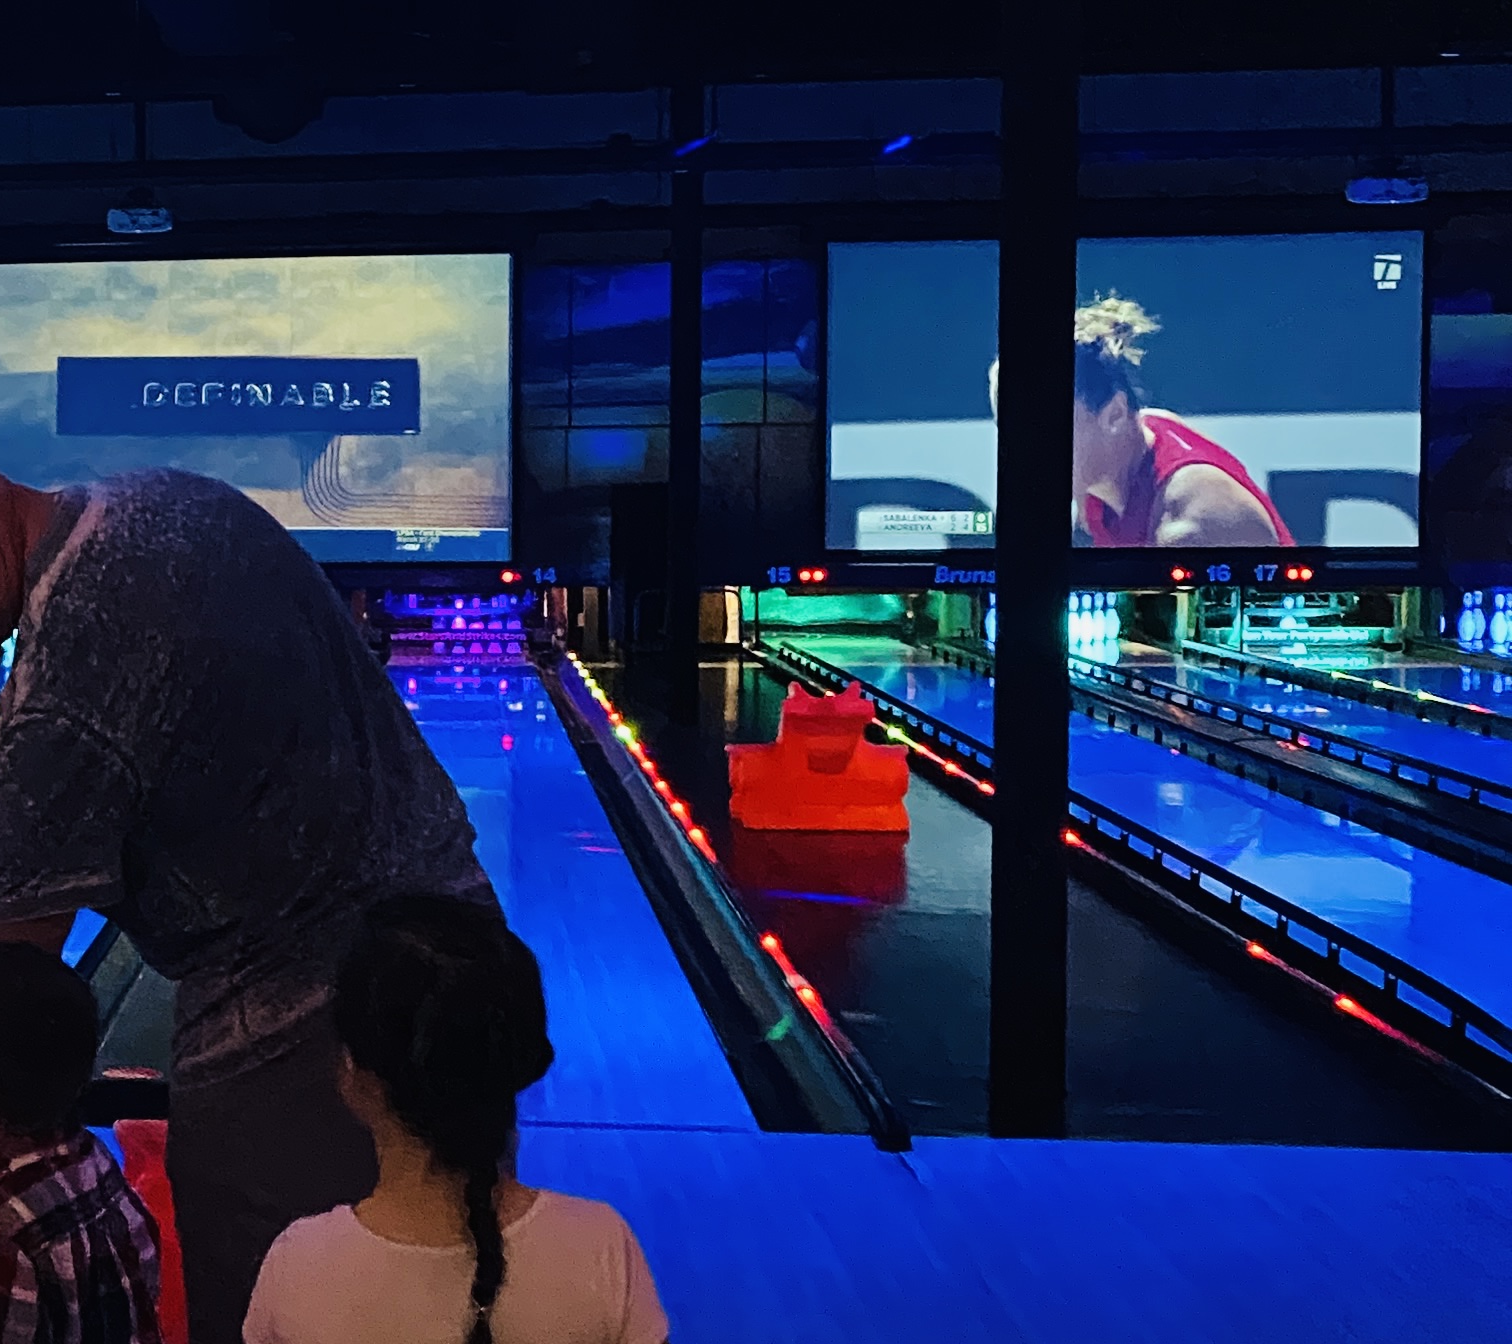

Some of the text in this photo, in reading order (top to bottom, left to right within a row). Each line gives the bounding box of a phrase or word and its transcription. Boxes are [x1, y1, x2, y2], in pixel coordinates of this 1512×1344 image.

[143, 381, 391, 411] DEFINABLE
[882, 513, 937, 522] SABALENKA
[963, 514, 970, 523] 2
[882, 523, 933, 532] ANDREEVA
[949, 523, 956, 532] 2
[532, 566, 557, 584] 14
[766, 566, 792, 584] 15
[1206, 563, 1232, 582] 16
[1254, 563, 1279, 582] 17
